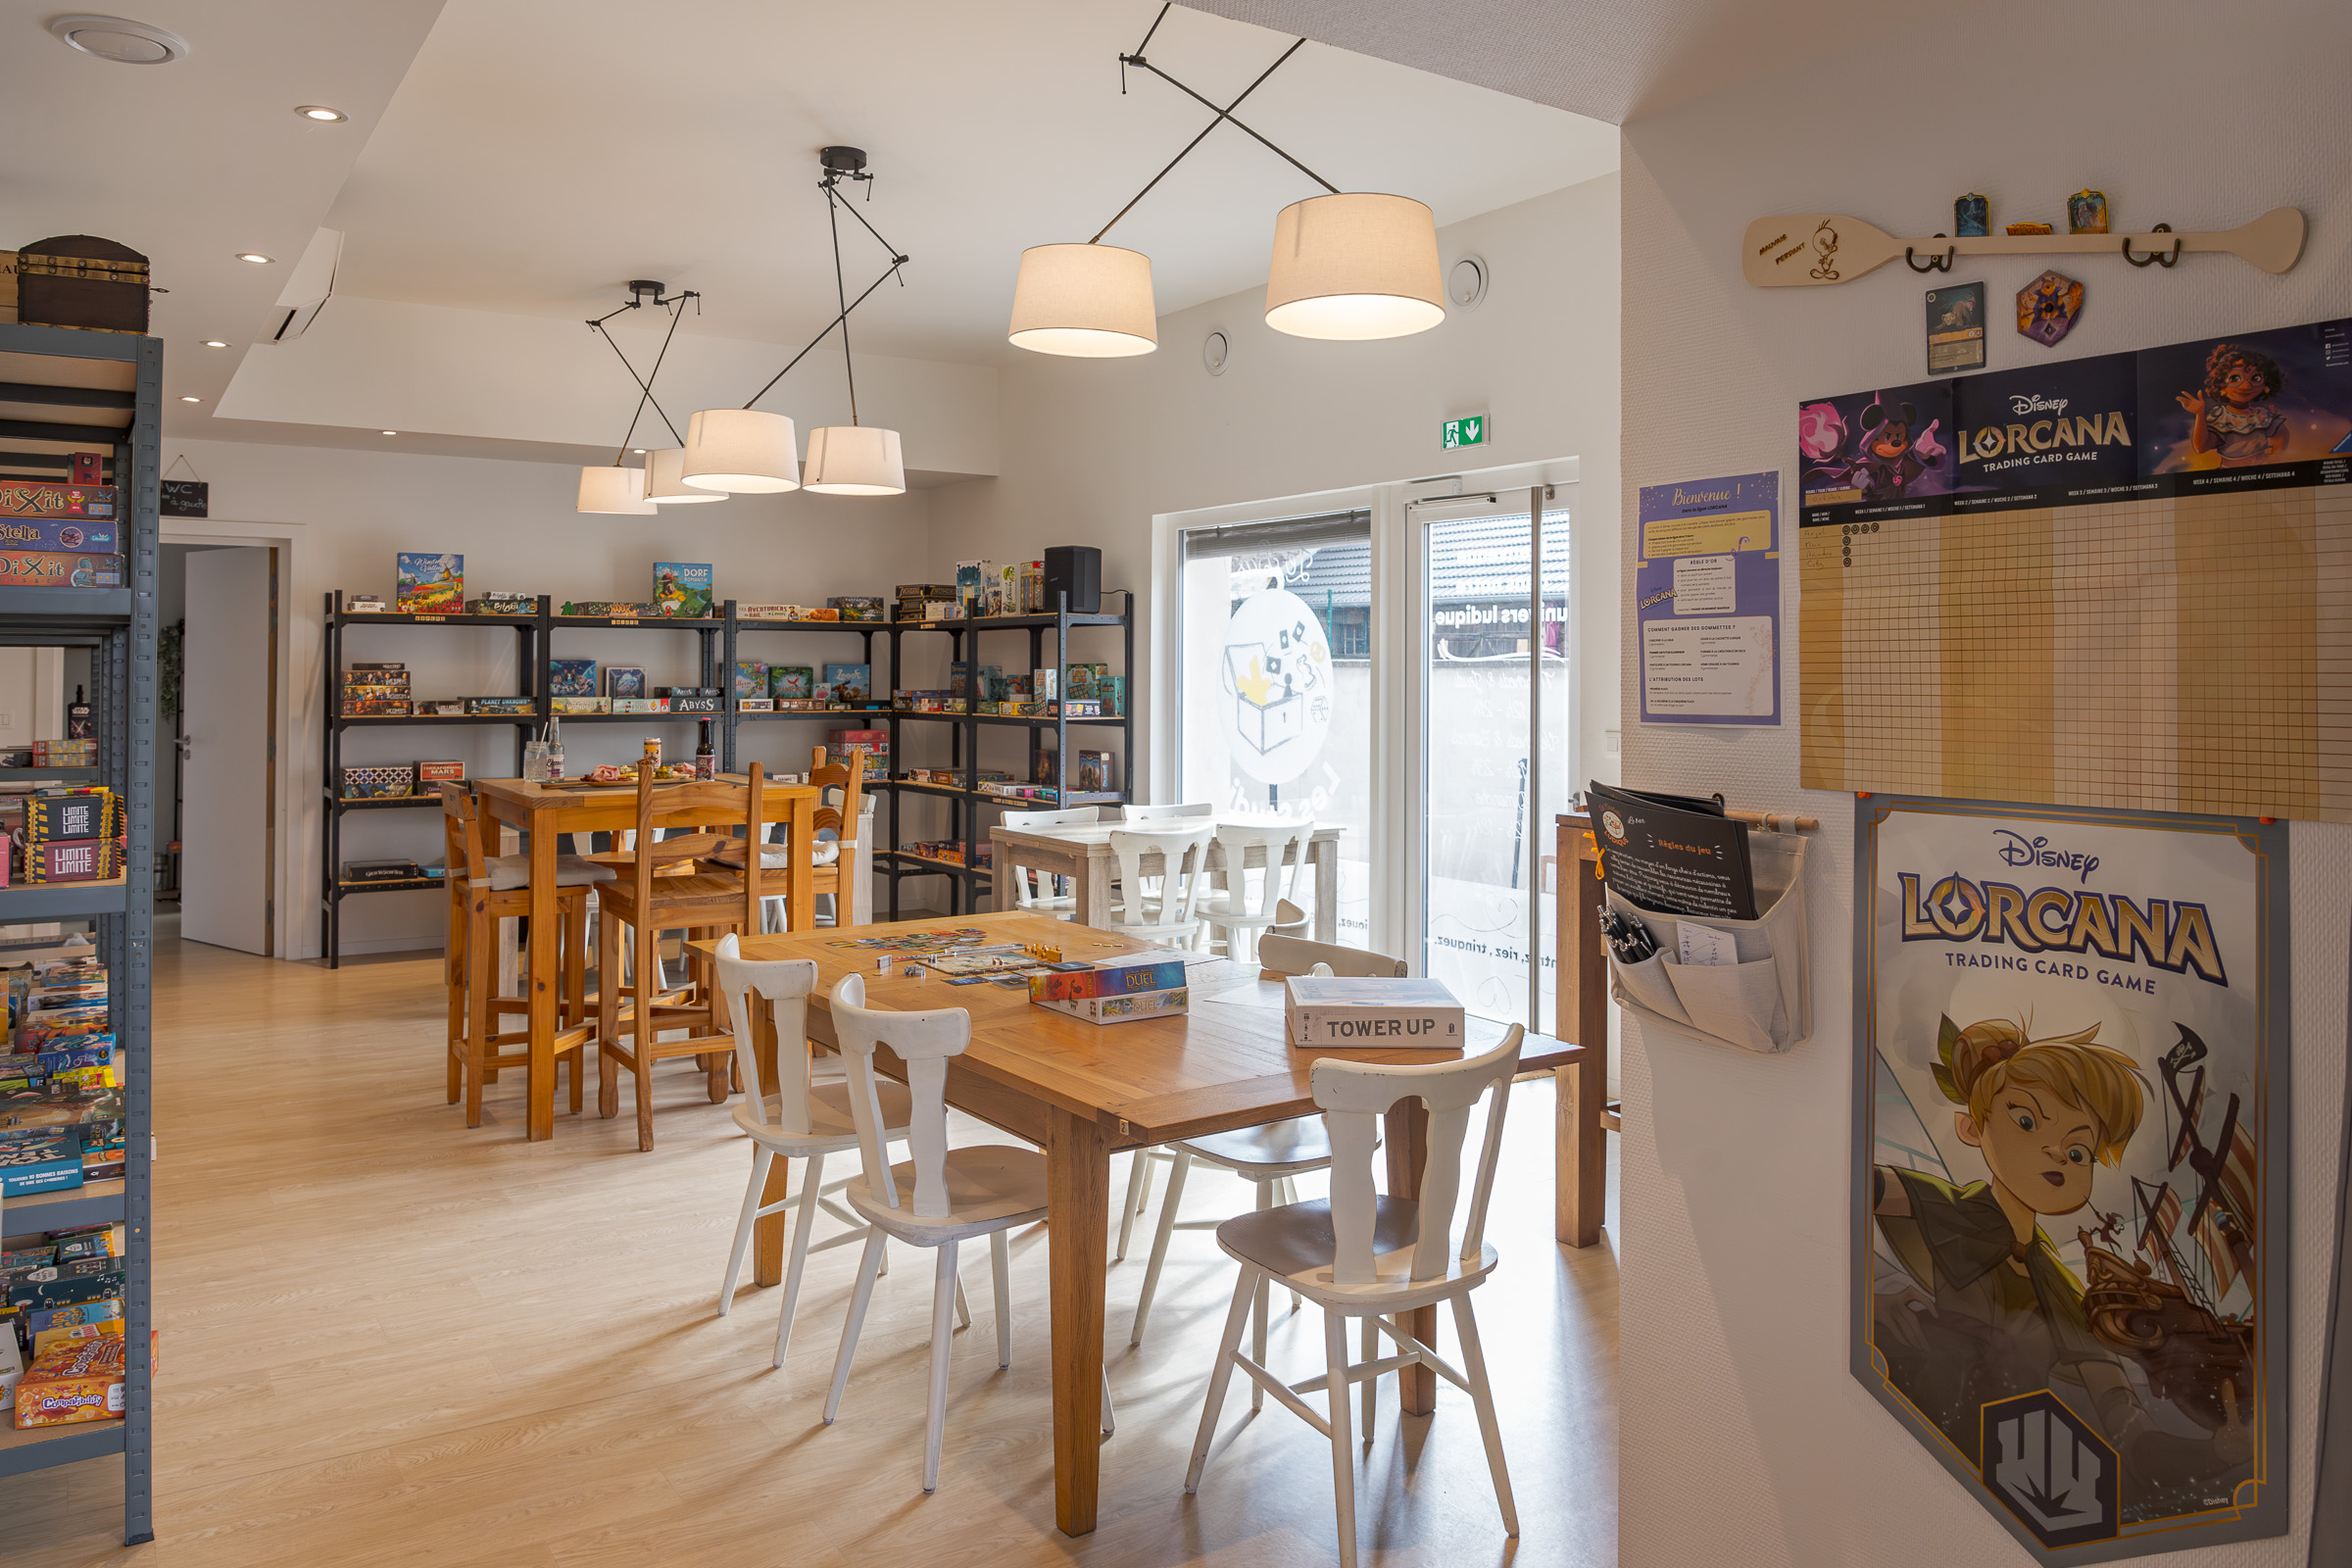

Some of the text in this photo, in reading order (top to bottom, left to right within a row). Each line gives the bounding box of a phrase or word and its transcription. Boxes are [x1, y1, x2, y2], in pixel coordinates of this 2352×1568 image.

[1759, 233, 1788, 256] MAUVAIS
[1775, 241, 1805, 266] PERDANT
[2009, 394, 2069, 416] Disney
[1958, 412, 2132, 466] LORCANA
[1983, 451, 2098, 473] TRADING CARD GAME
[165, 482, 193, 494] WC
[1672, 488, 1733, 507] Bienvenue
[684, 568, 709, 577] DORF
[1640, 588, 1678, 611] LORCANA
[679, 698, 714, 711] ABYSS
[63, 806, 89, 815] LIMITE
[63, 815, 89, 825] LIMITE
[63, 824, 89, 834] LIMITE
[55, 847, 92, 861] LIMITE
[1658, 839, 1712, 856] Règles du jeu
[1992, 829, 2100, 884] Disney
[55, 859, 92, 874] LIMITE
[1897, 870, 2230, 988] LORCANA
[1126, 973, 1156, 987] DUEL
[1945, 952, 2157, 996] TRADING CARD GAME
[1133, 1000, 1158, 1012] DUEL
[1327, 1018, 1436, 1038] TOWER UP
[42, 1394, 104, 1409] Compatibility
